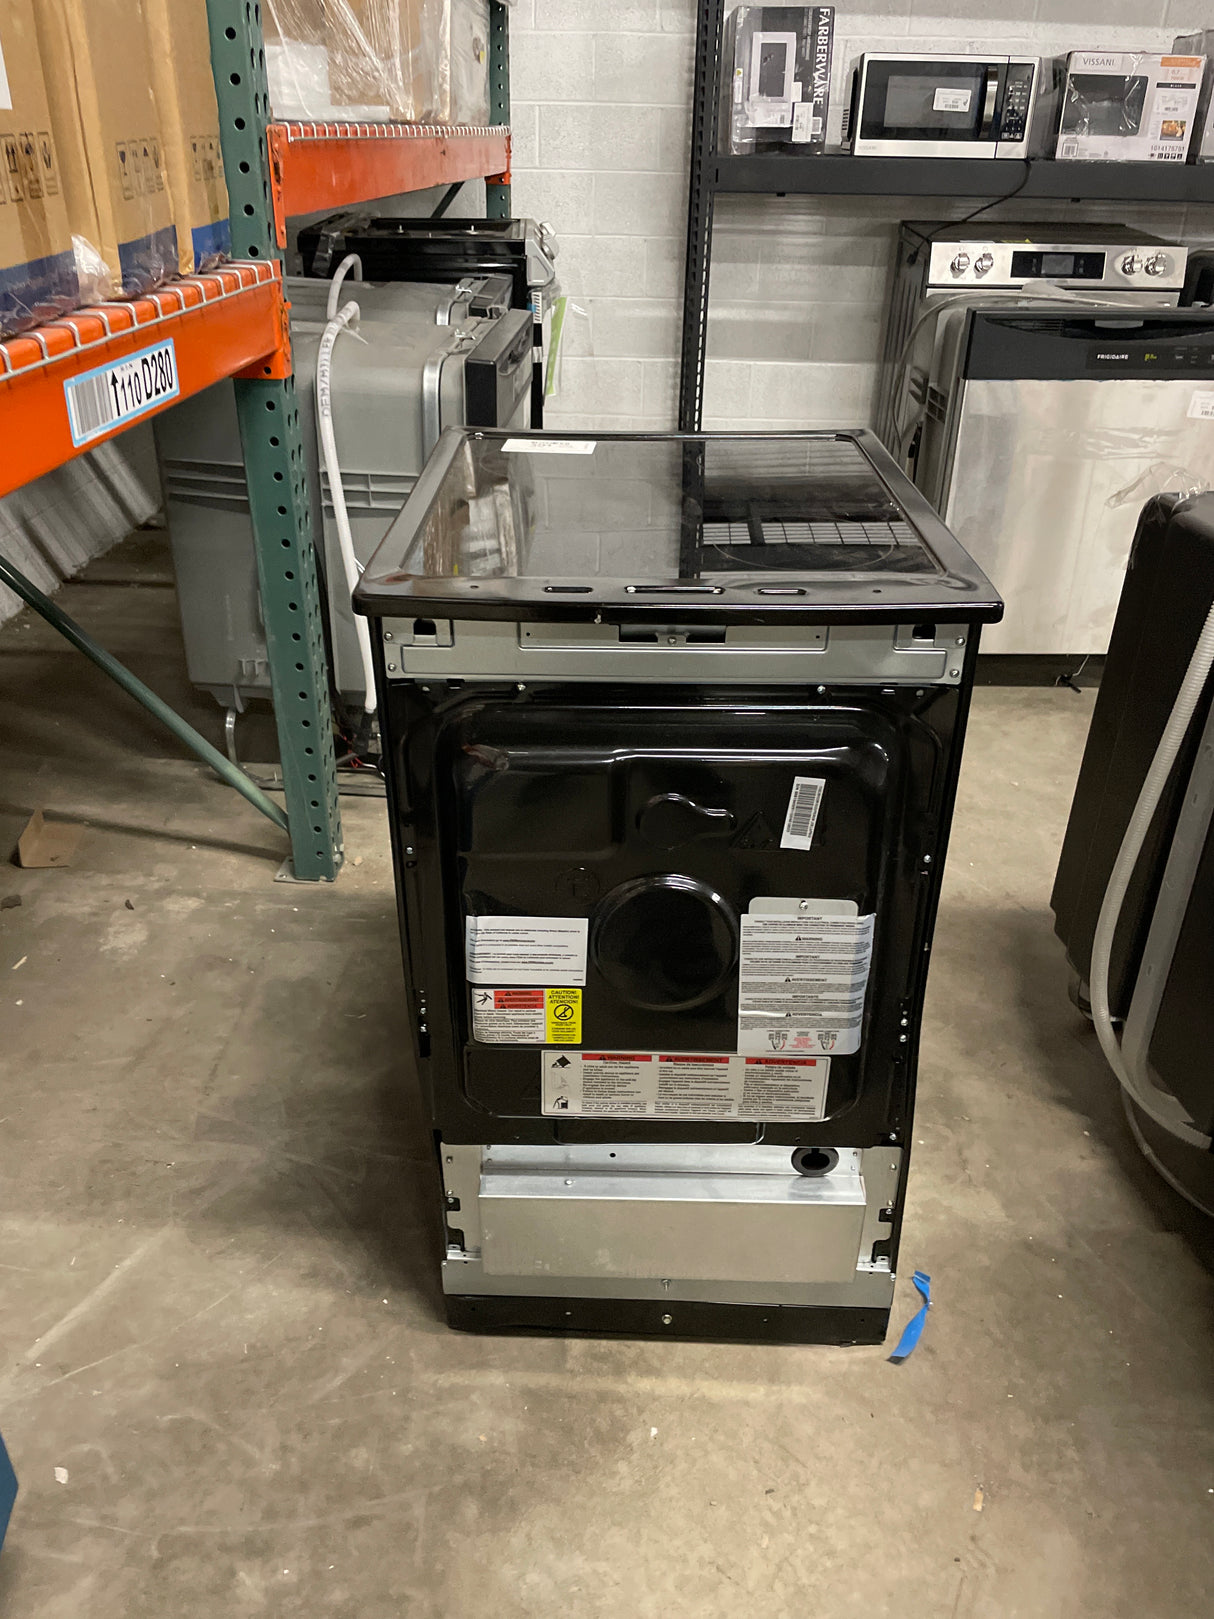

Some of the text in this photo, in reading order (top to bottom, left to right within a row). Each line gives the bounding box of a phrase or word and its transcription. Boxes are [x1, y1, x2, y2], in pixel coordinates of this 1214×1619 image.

[813, 7, 831, 105] FARBERWARE
[1083, 57, 1115, 66] VISSANI
[120, 347, 174, 411] 110 D280
